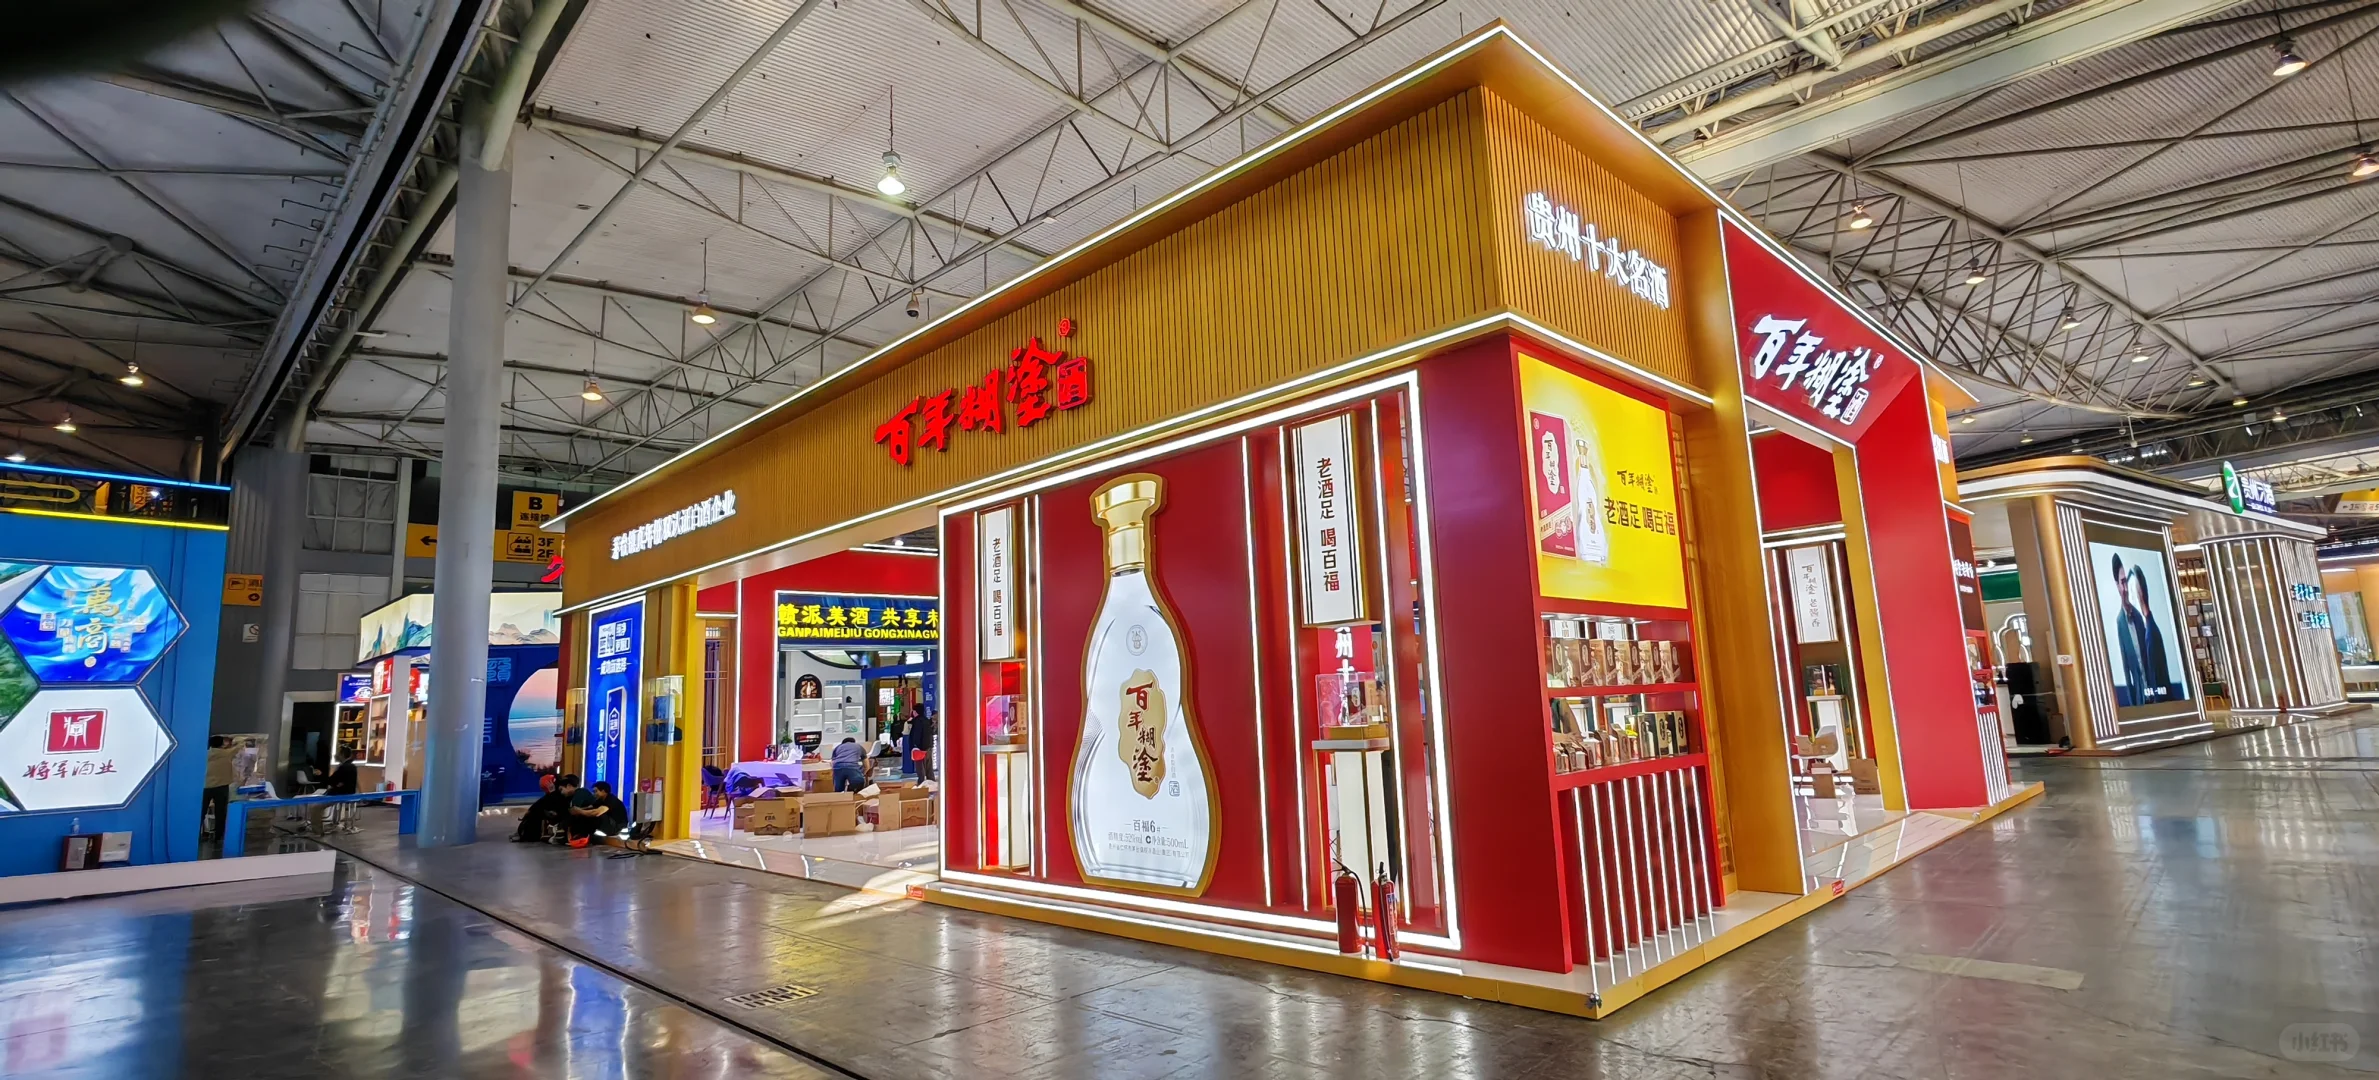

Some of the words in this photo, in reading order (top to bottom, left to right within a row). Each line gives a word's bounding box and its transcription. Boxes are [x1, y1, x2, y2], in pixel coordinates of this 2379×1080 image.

[1526, 191, 1671, 311] 贵州十大名酒
[1753, 313, 1872, 420] 百年糊涂
[874, 335, 1065, 467] 百年糊涂
[529, 496, 543, 511] B
[1316, 457, 1335, 520] 老酒足
[1603, 496, 1642, 529] 老酒足
[1641, 506, 1676, 536] 喝百福
[537, 537, 555, 547] 3F
[1320, 527, 1340, 592] 喝百福
[777, 603, 871, 626] 赣派美酒
[777, 626, 862, 638] GANPAIMEIJIU
[1125, 681, 1159, 783] 百年糊涂
[22, 758, 118, 781] 将军酒业
